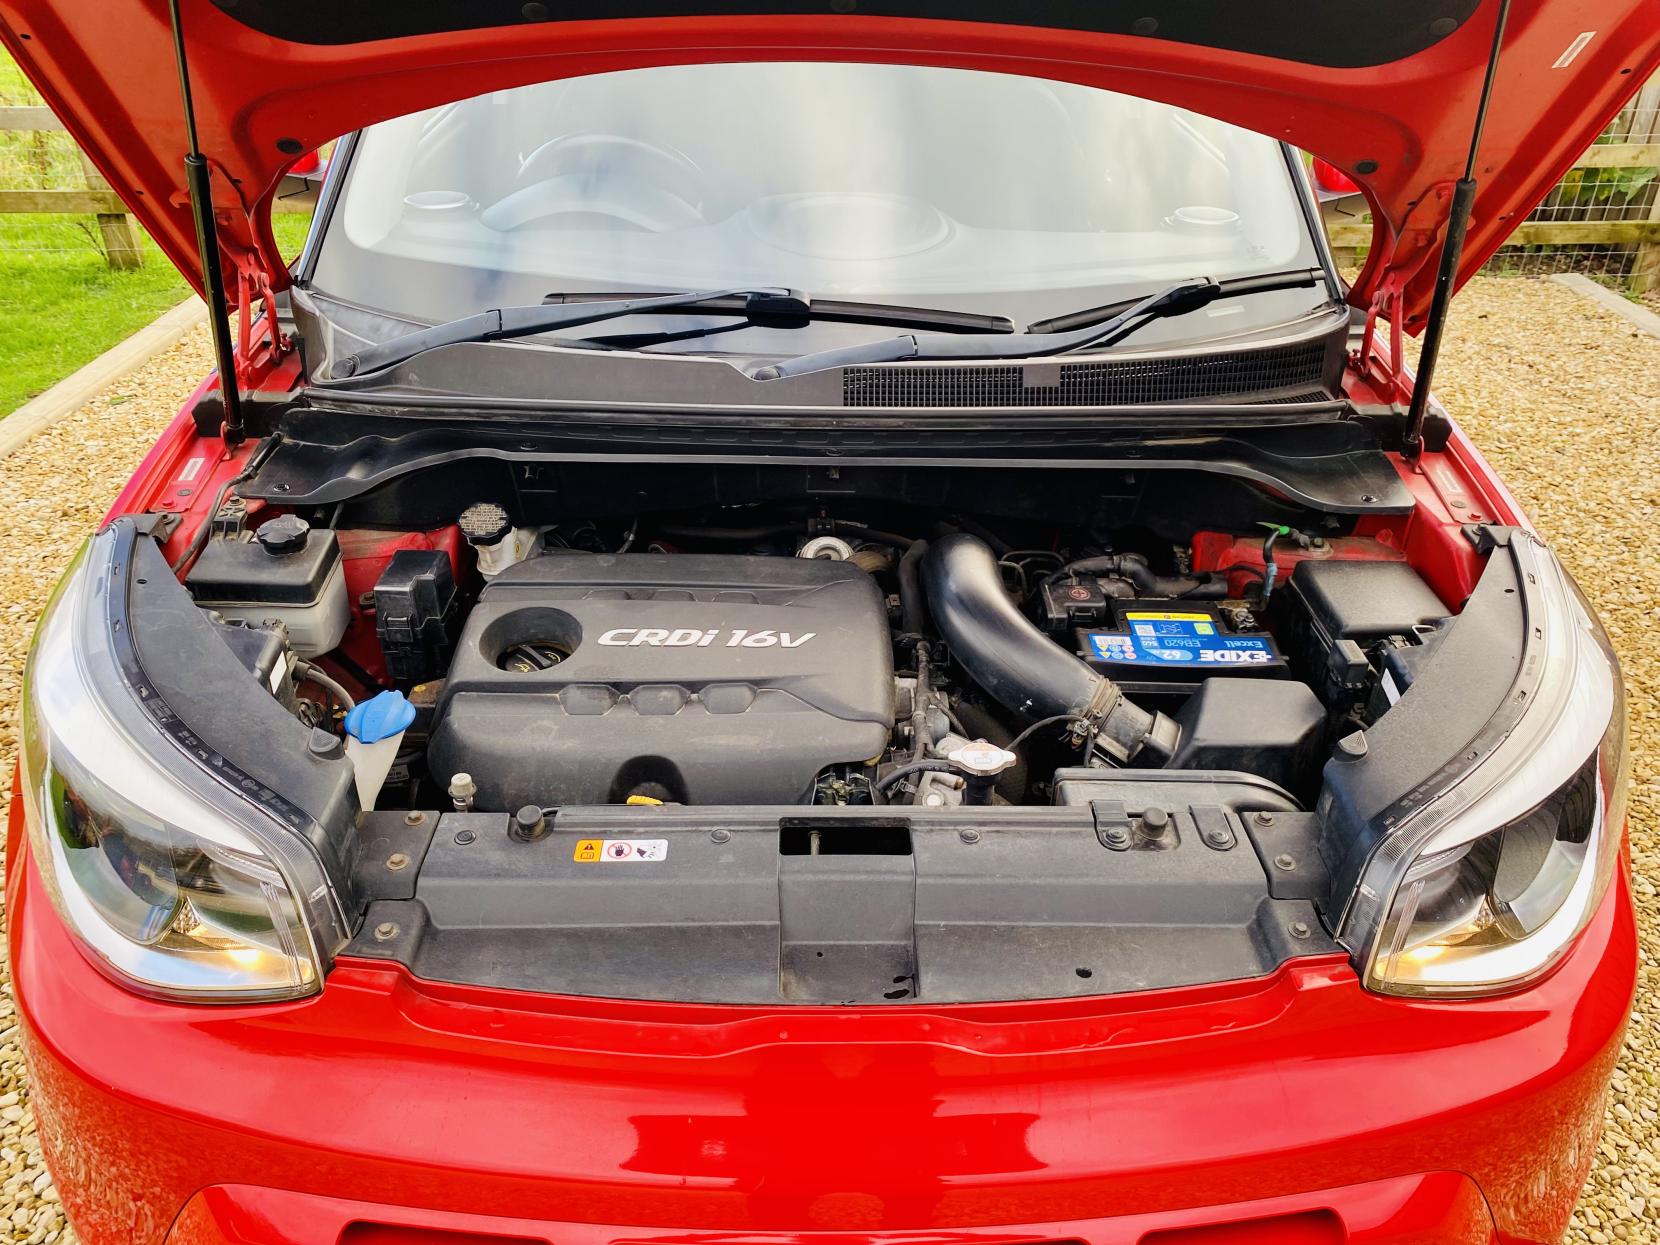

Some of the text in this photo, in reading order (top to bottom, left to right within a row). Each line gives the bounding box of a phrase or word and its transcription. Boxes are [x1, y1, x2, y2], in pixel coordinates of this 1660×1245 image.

[597, 628, 817, 648] CRDi 16V
[1165, 638, 1201, 647] EB620
[1224, 639, 1264, 648] Excell
[1200, 649, 1271, 662] EXIDE
